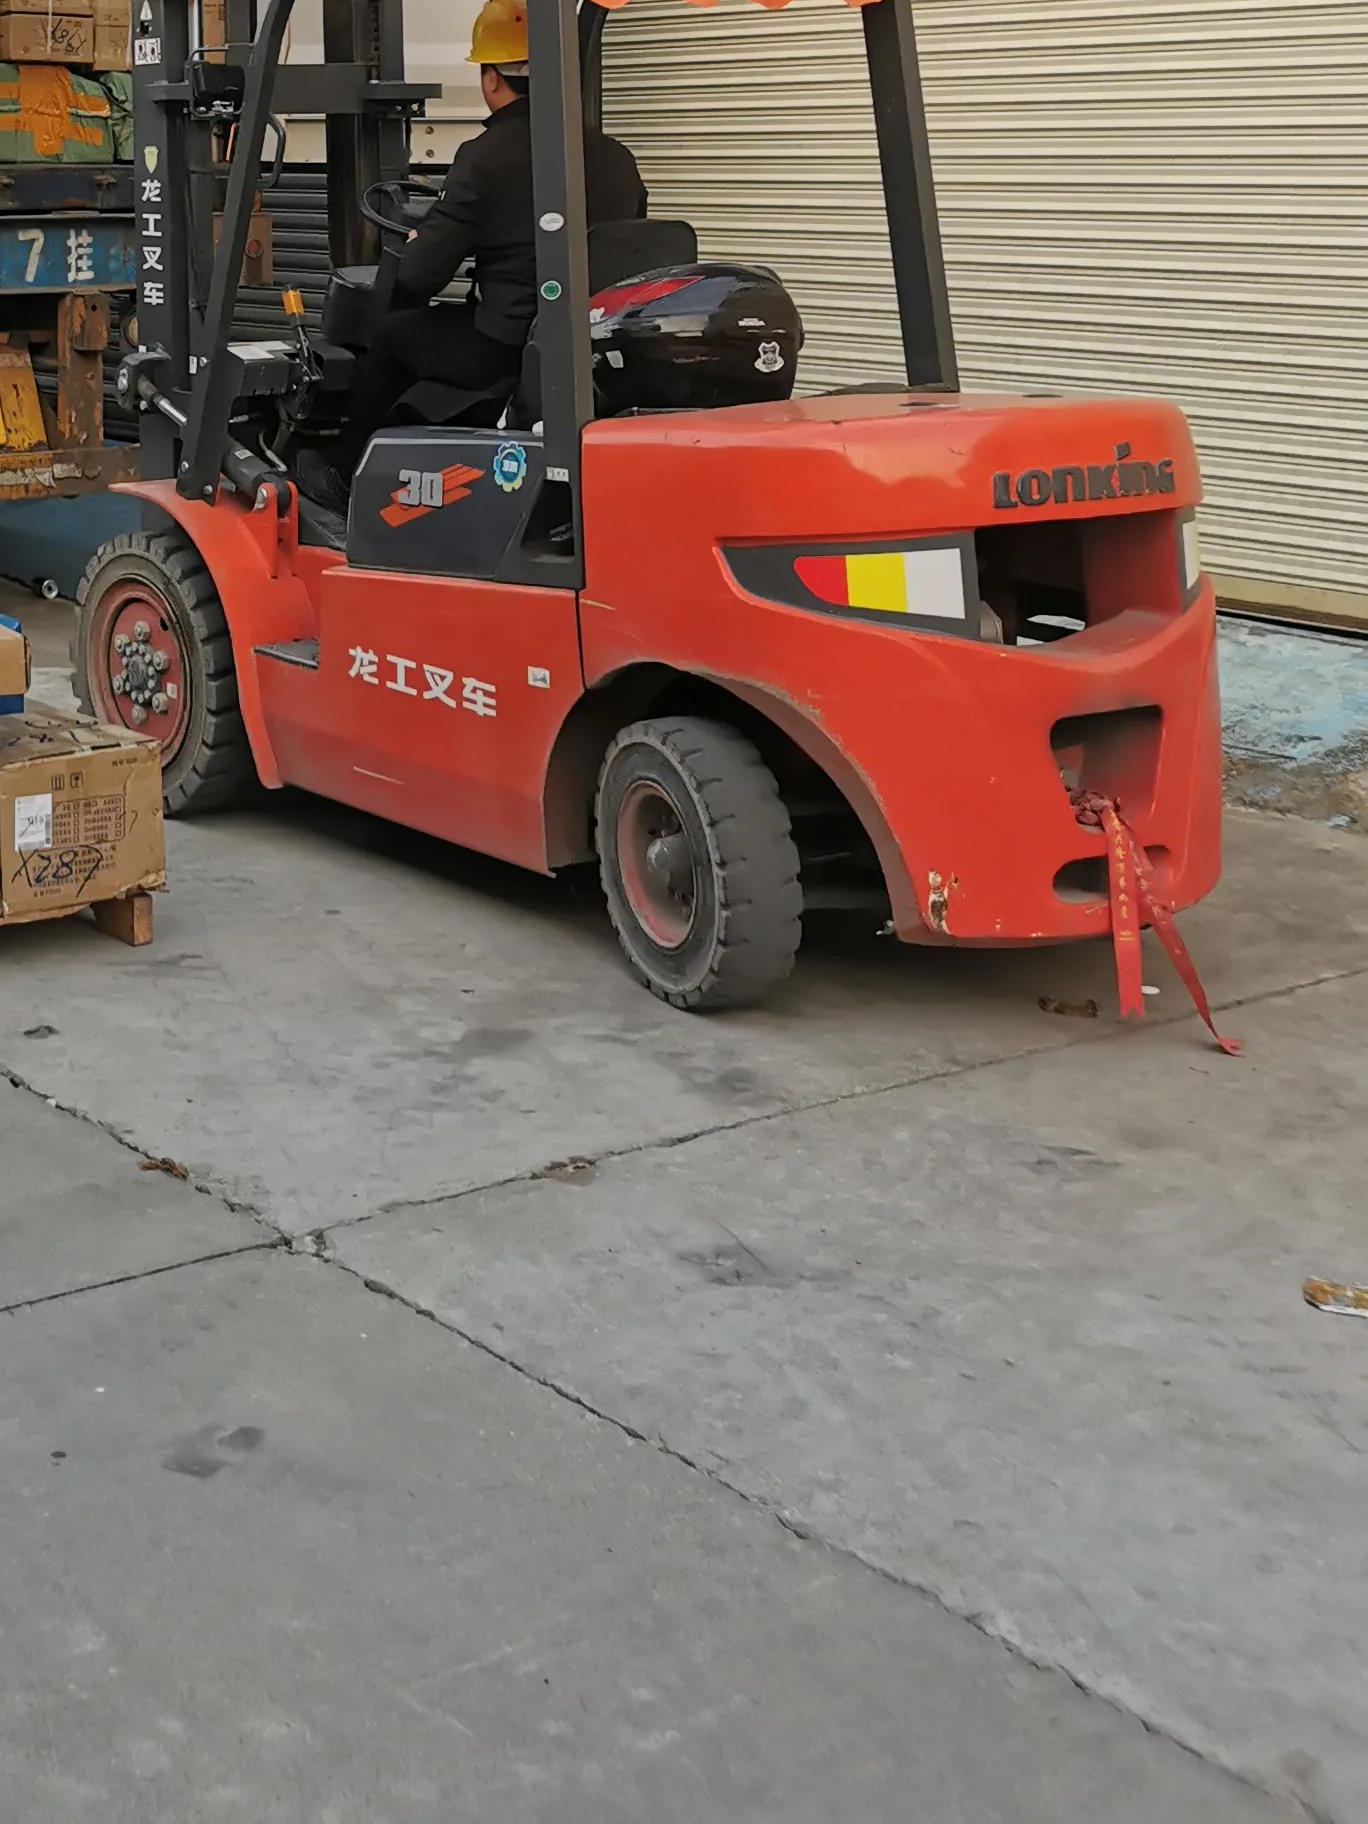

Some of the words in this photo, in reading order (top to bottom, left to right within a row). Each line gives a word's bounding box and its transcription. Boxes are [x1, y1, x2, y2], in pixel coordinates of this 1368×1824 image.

[140, 179, 165, 306] 龙工叉车
[398, 469, 445, 508] 30
[347, 644, 498, 718] 龙工叉车
[11, 844, 104, 899] X287
